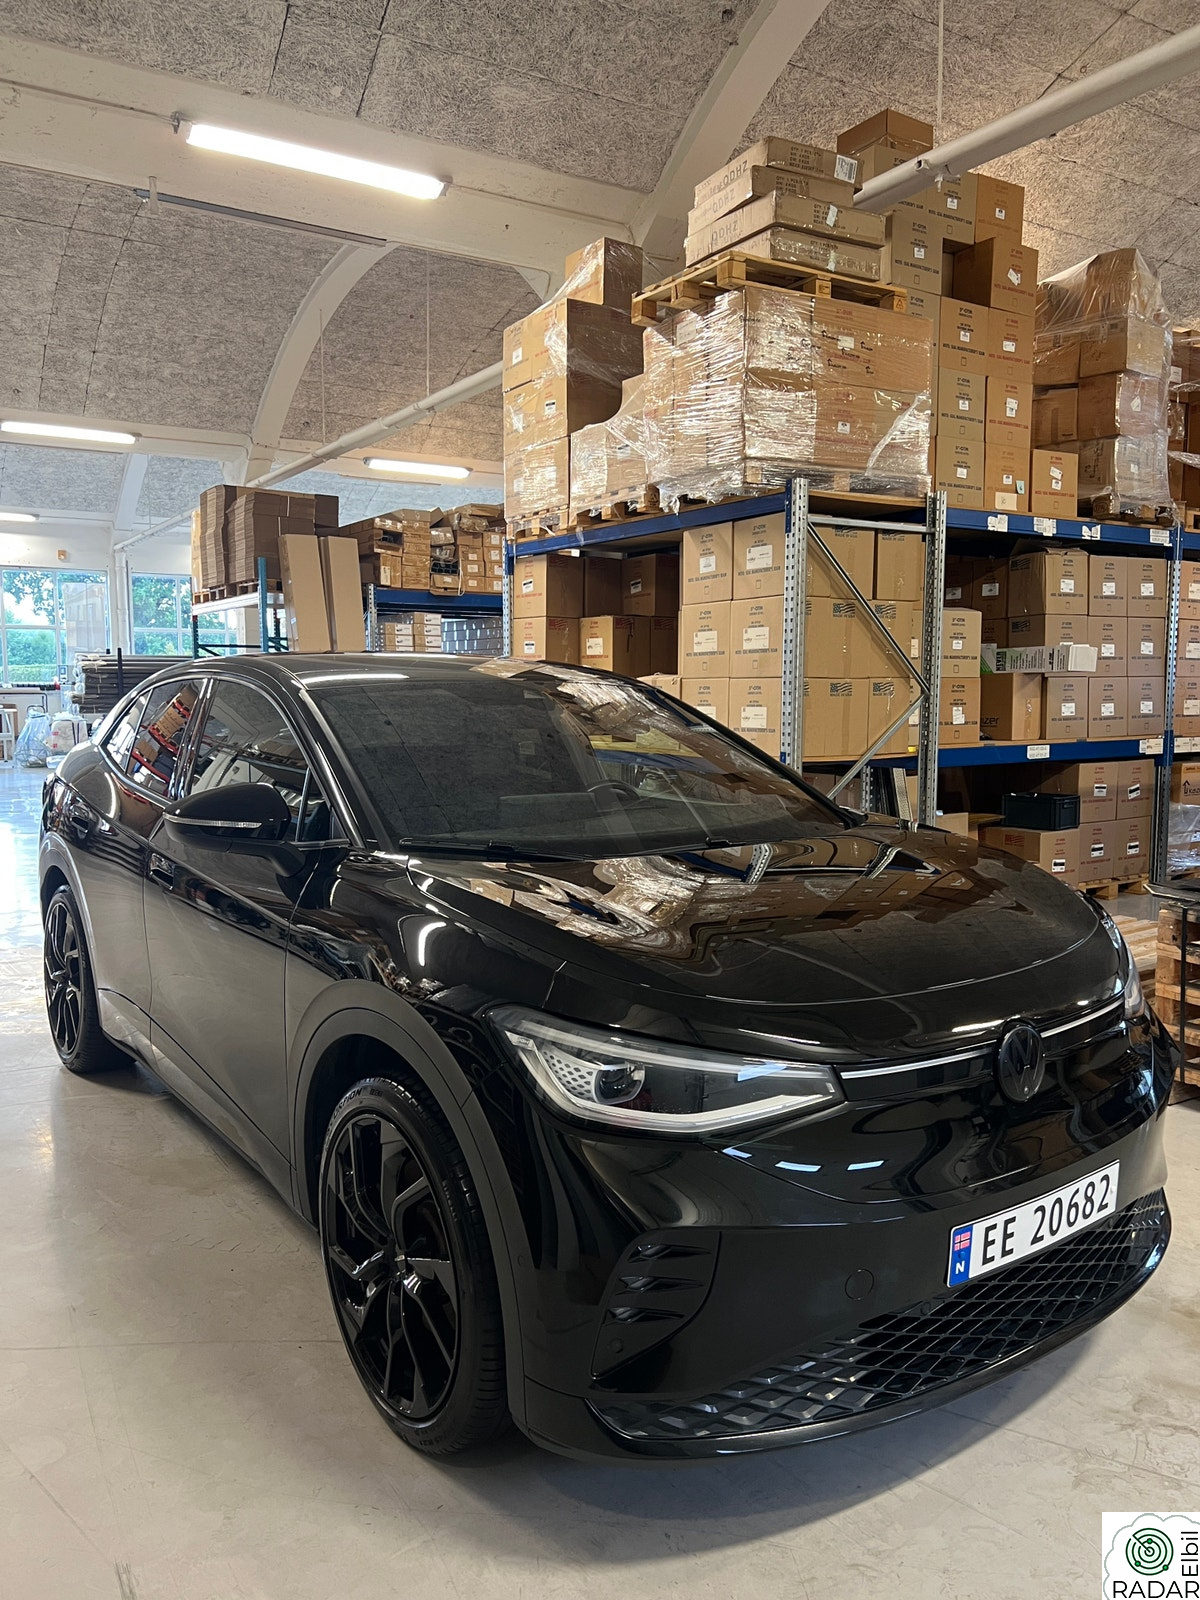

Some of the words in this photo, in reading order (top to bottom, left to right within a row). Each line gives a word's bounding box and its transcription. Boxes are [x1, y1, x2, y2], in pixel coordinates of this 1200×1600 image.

[722, 160, 748, 185] QDHZ
[713, 188, 736, 213] QDHZ
[712, 221, 738, 241] QDHZ
[982, 1216, 1016, 1266] EE
[1030, 1174, 1111, 1246] 20682
[955, 1261, 965, 1274] N
